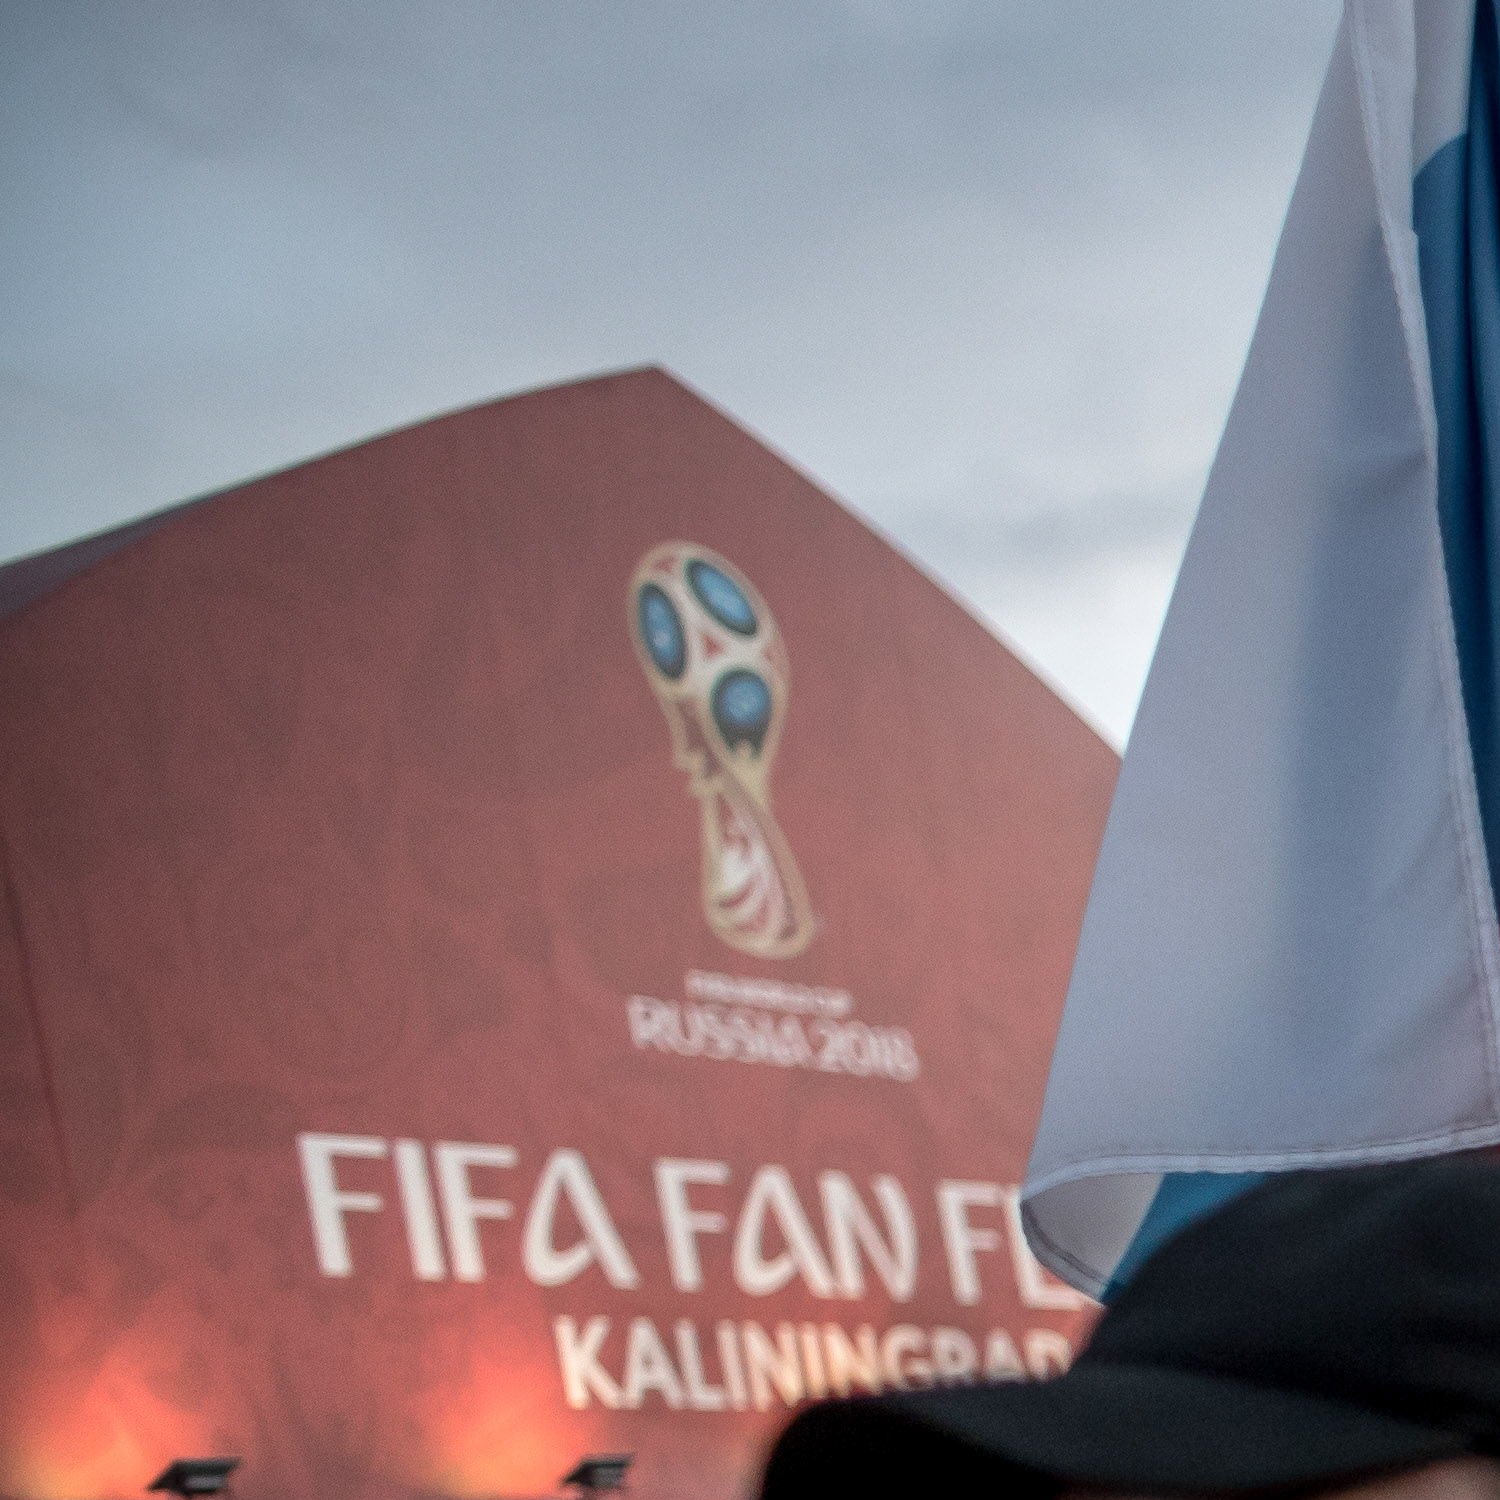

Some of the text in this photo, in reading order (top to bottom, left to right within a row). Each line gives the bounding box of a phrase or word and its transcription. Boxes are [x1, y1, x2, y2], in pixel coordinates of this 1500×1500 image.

[626, 994, 920, 1082] RUSSIA 2018
[298, 1132, 640, 1290] FIFA
[652, 1156, 918, 1303] FAN
